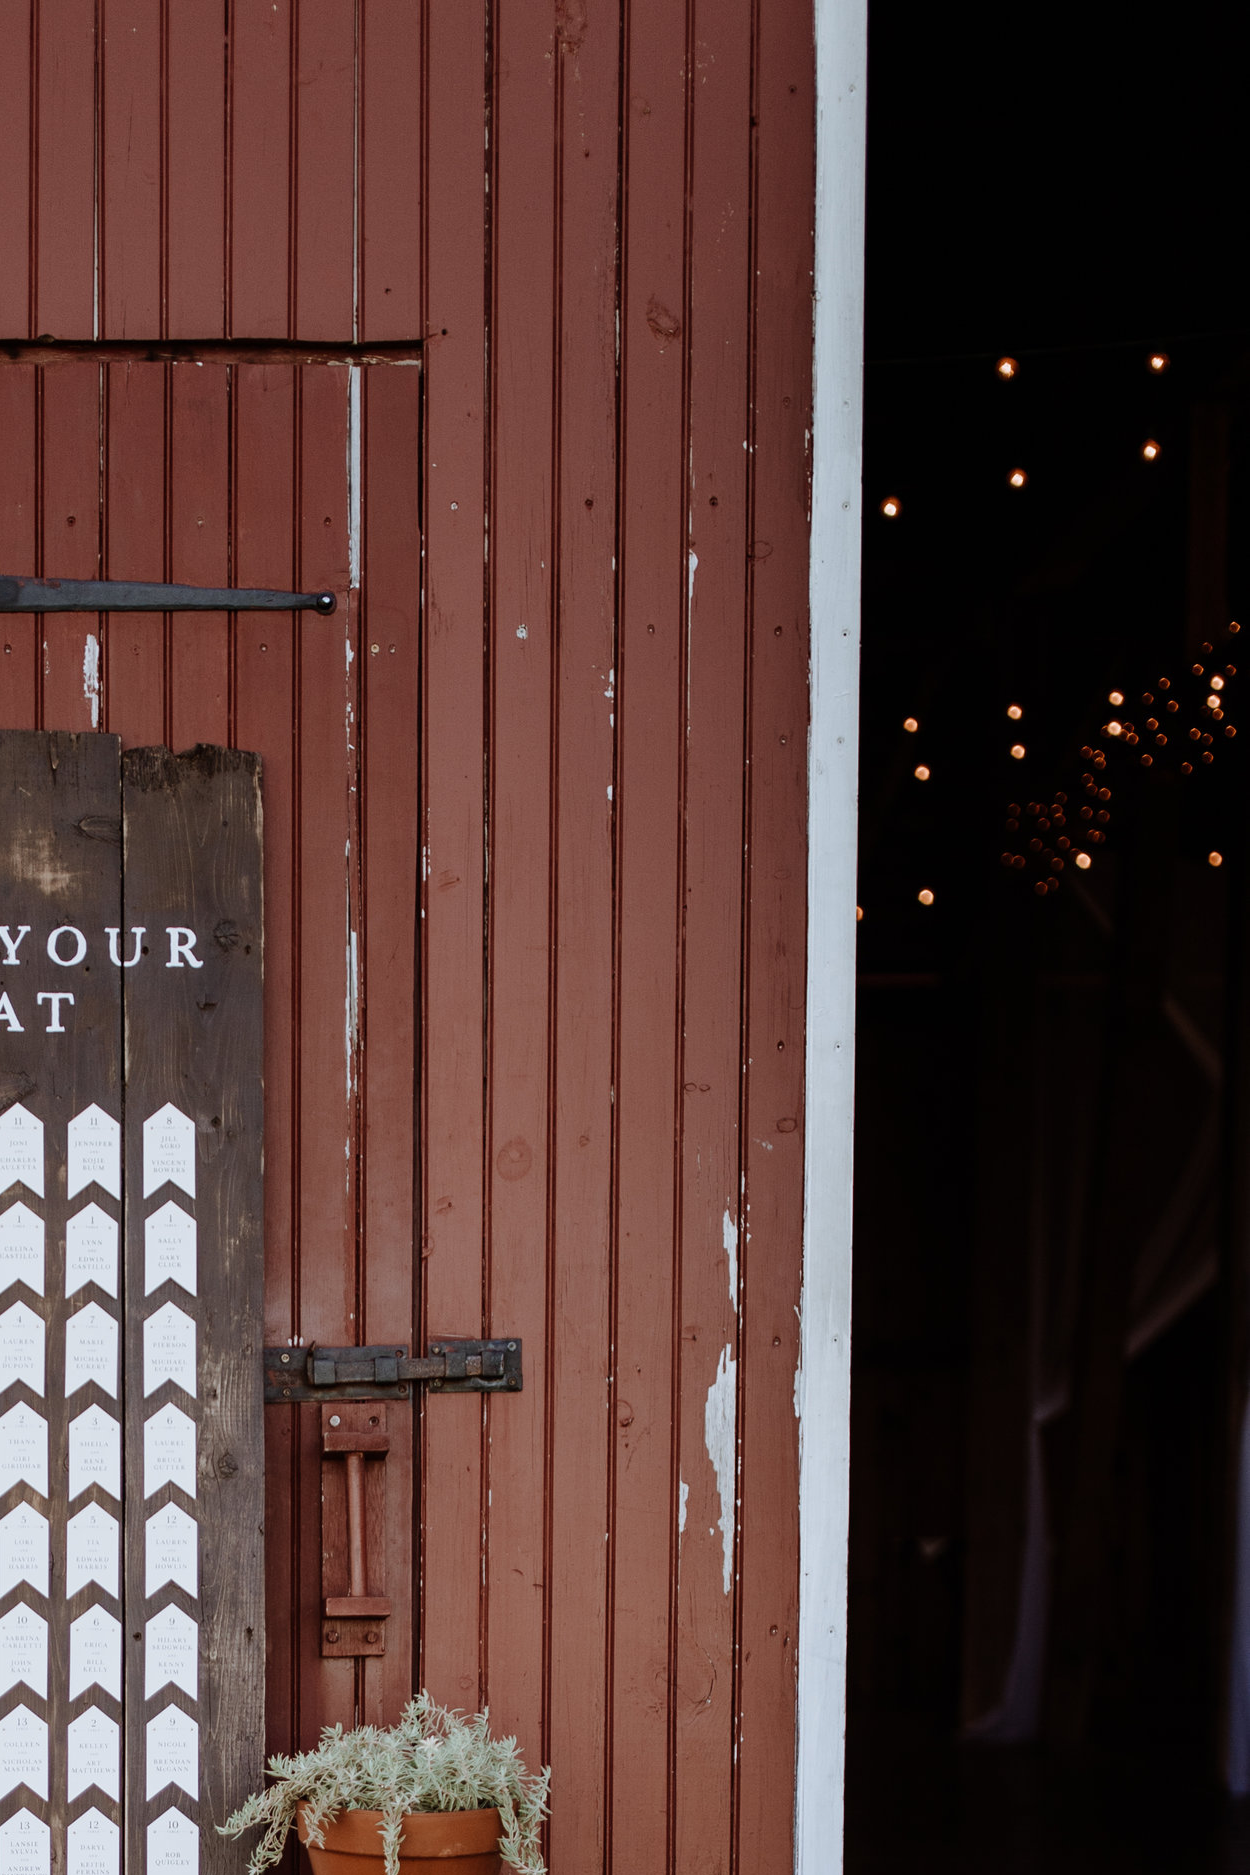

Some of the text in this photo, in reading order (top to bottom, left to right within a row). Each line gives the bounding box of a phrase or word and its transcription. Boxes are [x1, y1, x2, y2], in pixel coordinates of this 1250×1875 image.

[14, 1117, 22, 1126] 11
[90, 1117, 98, 1126] 11
[161, 1135, 178, 1143] JILL
[0, 1252, 39, 1260] CASTILLO
[73, 1355, 108, 1363] MICHAEL
[167, 1515, 177, 1524] 12
[17, 1616, 28, 1624] 10
[17, 1717, 28, 1726] 13
[20, 1821, 30, 1830] 13
[89, 1821, 99, 1829] 12
[168, 1821, 179, 1829] 10
